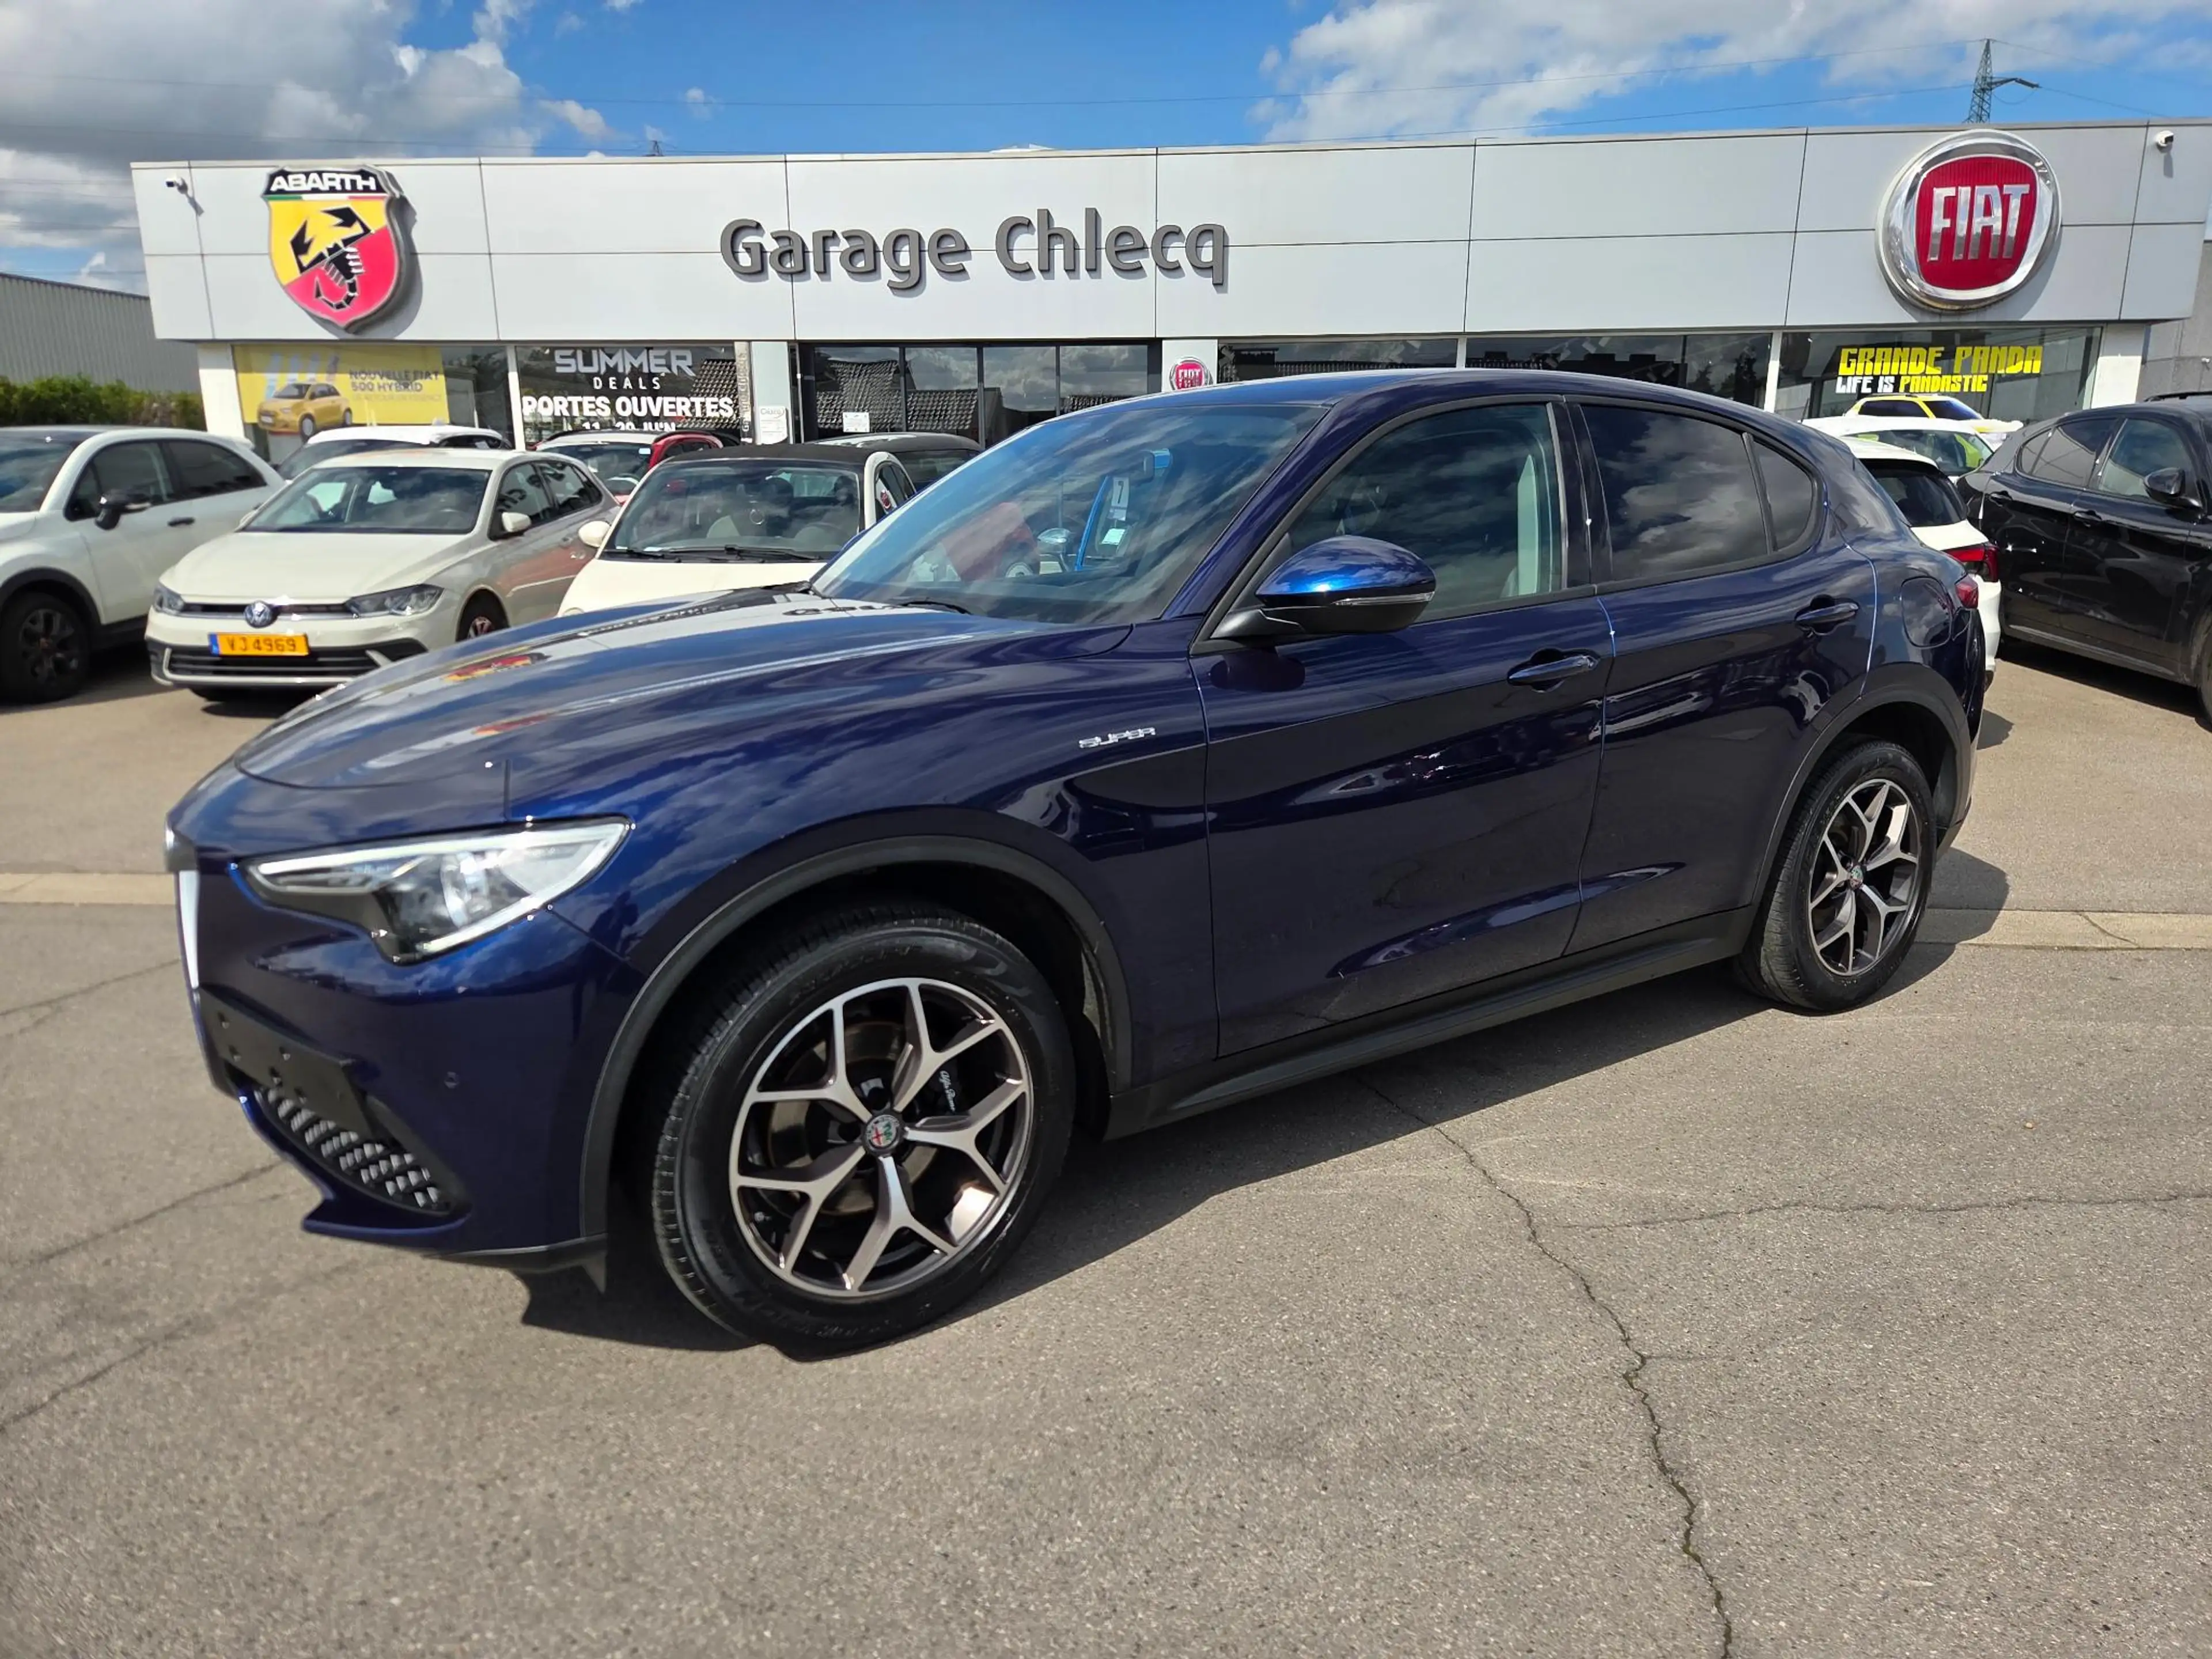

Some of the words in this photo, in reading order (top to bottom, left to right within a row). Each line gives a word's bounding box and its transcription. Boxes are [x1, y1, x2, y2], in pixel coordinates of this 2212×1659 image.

[270, 173, 376, 191] ABARTH
[1927, 184, 2030, 262] FIAT
[721, 218, 968, 289] Garage
[995, 207, 1226, 285] Chlecq
[554, 349, 696, 377] SUMMER
[1839, 347, 1944, 375] GRANDE
[1953, 346, 2043, 374] PANDA
[413, 370, 440, 380] FIAT
[593, 377, 661, 390] DEALS
[1179, 369, 1200, 388] FIAT
[1835, 376, 1873, 394] LIFE
[1877, 376, 1895, 393] IS
[1899, 374, 1988, 392] PANDASTIC
[351, 381, 374, 392] 500
[378, 381, 423, 392] HYBRID
[521, 396, 611, 417] PORTES
[615, 395, 733, 417] OUVERTES
[1078, 727, 1156, 748] SUPER
